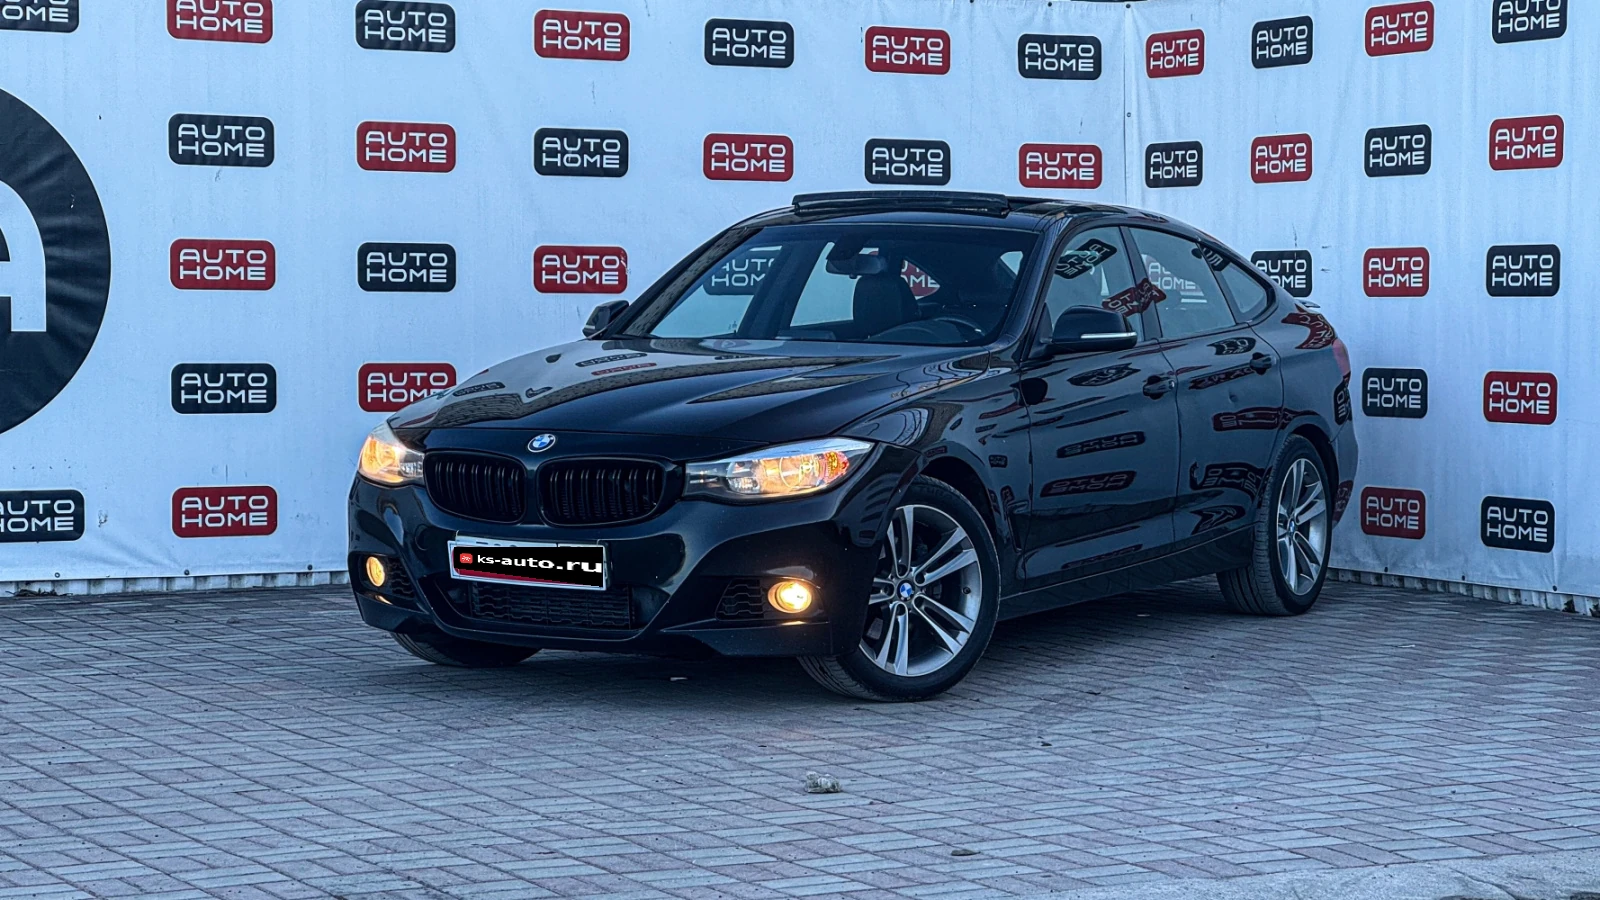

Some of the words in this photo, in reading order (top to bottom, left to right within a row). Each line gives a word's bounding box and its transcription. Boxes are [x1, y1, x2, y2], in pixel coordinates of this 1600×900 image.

[2, 5, 69, 22] OME
[176, 0, 264, 17] AUTO
[1499, 0, 1561, 16] AUTO
[176, 14, 263, 34] HOME
[364, 9, 447, 27] AUTO
[1371, 11, 1428, 30] AUTO
[1498, 13, 1560, 33] HOME
[365, 25, 446, 43] HOME
[543, 19, 622, 36] AUTO
[713, 28, 787, 43] AUTO
[1257, 25, 1308, 44] AUTO
[543, 35, 621, 52] HOME
[873, 35, 943, 51] AUTO
[1371, 27, 1427, 47] HOME
[712, 43, 786, 59] HOME
[1025, 42, 1094, 57] AUTO
[1151, 38, 1200, 55] AUTO
[1256, 41, 1307, 59] HOME
[873, 50, 943, 66] HOME
[1025, 57, 1094, 71] HOME
[1150, 53, 1199, 69] HOME
[178, 124, 265, 140] AUTO
[366, 131, 448, 147] AUTO
[1495, 125, 1557, 143] AUTO
[178, 140, 264, 157] HOME
[542, 137, 621, 152] AUTO
[711, 142, 786, 157] AUTO
[1370, 134, 1425, 151] AUTO
[366, 147, 446, 163] HOME
[872, 147, 943, 162] AUTO
[1026, 152, 1095, 166] AUTO
[1150, 150, 1198, 164] AUTO
[1256, 143, 1307, 159] AUTO
[1370, 151, 1424, 167] HOME
[1495, 143, 1556, 160] HOME
[542, 153, 619, 168] HOME
[711, 158, 785, 172] HOME
[1256, 158, 1306, 174] HOME
[872, 162, 943, 177] HOME
[1026, 167, 1094, 180] HOME
[1150, 165, 1197, 179] HOME
[180, 249, 267, 264] AUTO
[367, 252, 448, 266] AUTO
[542, 255, 620, 269] AUTO
[1369, 257, 1424, 271] AUTO
[1492, 254, 1554, 269] AUTO
[180, 265, 266, 280] HOME
[1255, 259, 1307, 273] AUTO
[367, 268, 447, 282] HOME
[542, 270, 619, 284] HOME
[711, 273, 766, 286] HOM
[900, 274, 940, 288] ME
[1270, 275, 1306, 288] ME
[1368, 273, 1423, 287] HOME
[1492, 272, 1553, 286] HOME
[181, 373, 268, 387] AUTO
[367, 373, 448, 386] AUTO
[1367, 377, 1422, 392] AUTO
[181, 390, 267, 404] HOME
[367, 389, 444, 402] HOM
[1490, 381, 1551, 397] AUTO
[1367, 393, 1421, 409] HOME
[1489, 398, 1549, 414] HOME
[0, 500, 75, 515] UTO
[182, 496, 268, 511] AUTO
[1366, 496, 1420, 513] AUTO
[0, 516, 74, 532] OME
[182, 512, 267, 528] HOME
[1366, 512, 1419, 530] HOME
[1488, 507, 1548, 525] AUTO
[1487, 523, 1547, 542] HOME
